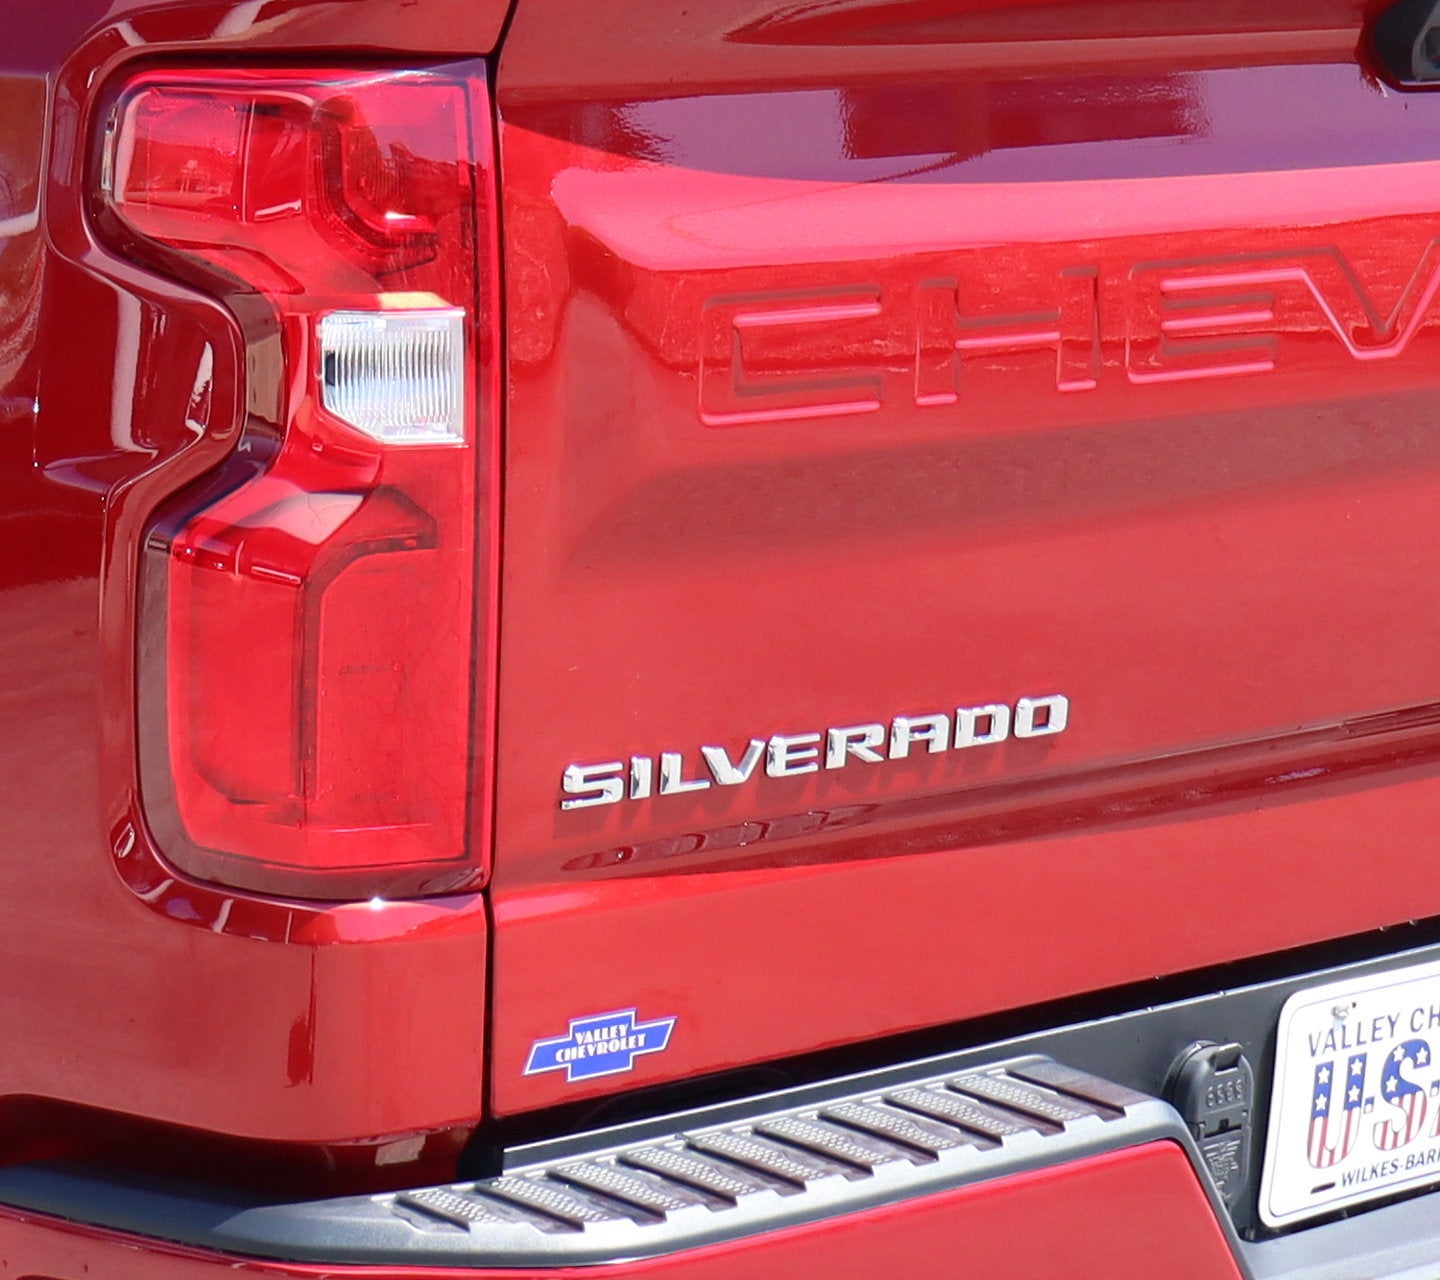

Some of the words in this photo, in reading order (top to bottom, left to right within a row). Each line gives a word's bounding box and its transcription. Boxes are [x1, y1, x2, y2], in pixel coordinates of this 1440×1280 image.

[561, 694, 1069, 811] SILVERADO
[555, 1034, 646, 1062] CHEVROLET
[575, 1024, 628, 1045] VALLEY
[1308, 1012, 1400, 1058] VALLEY
